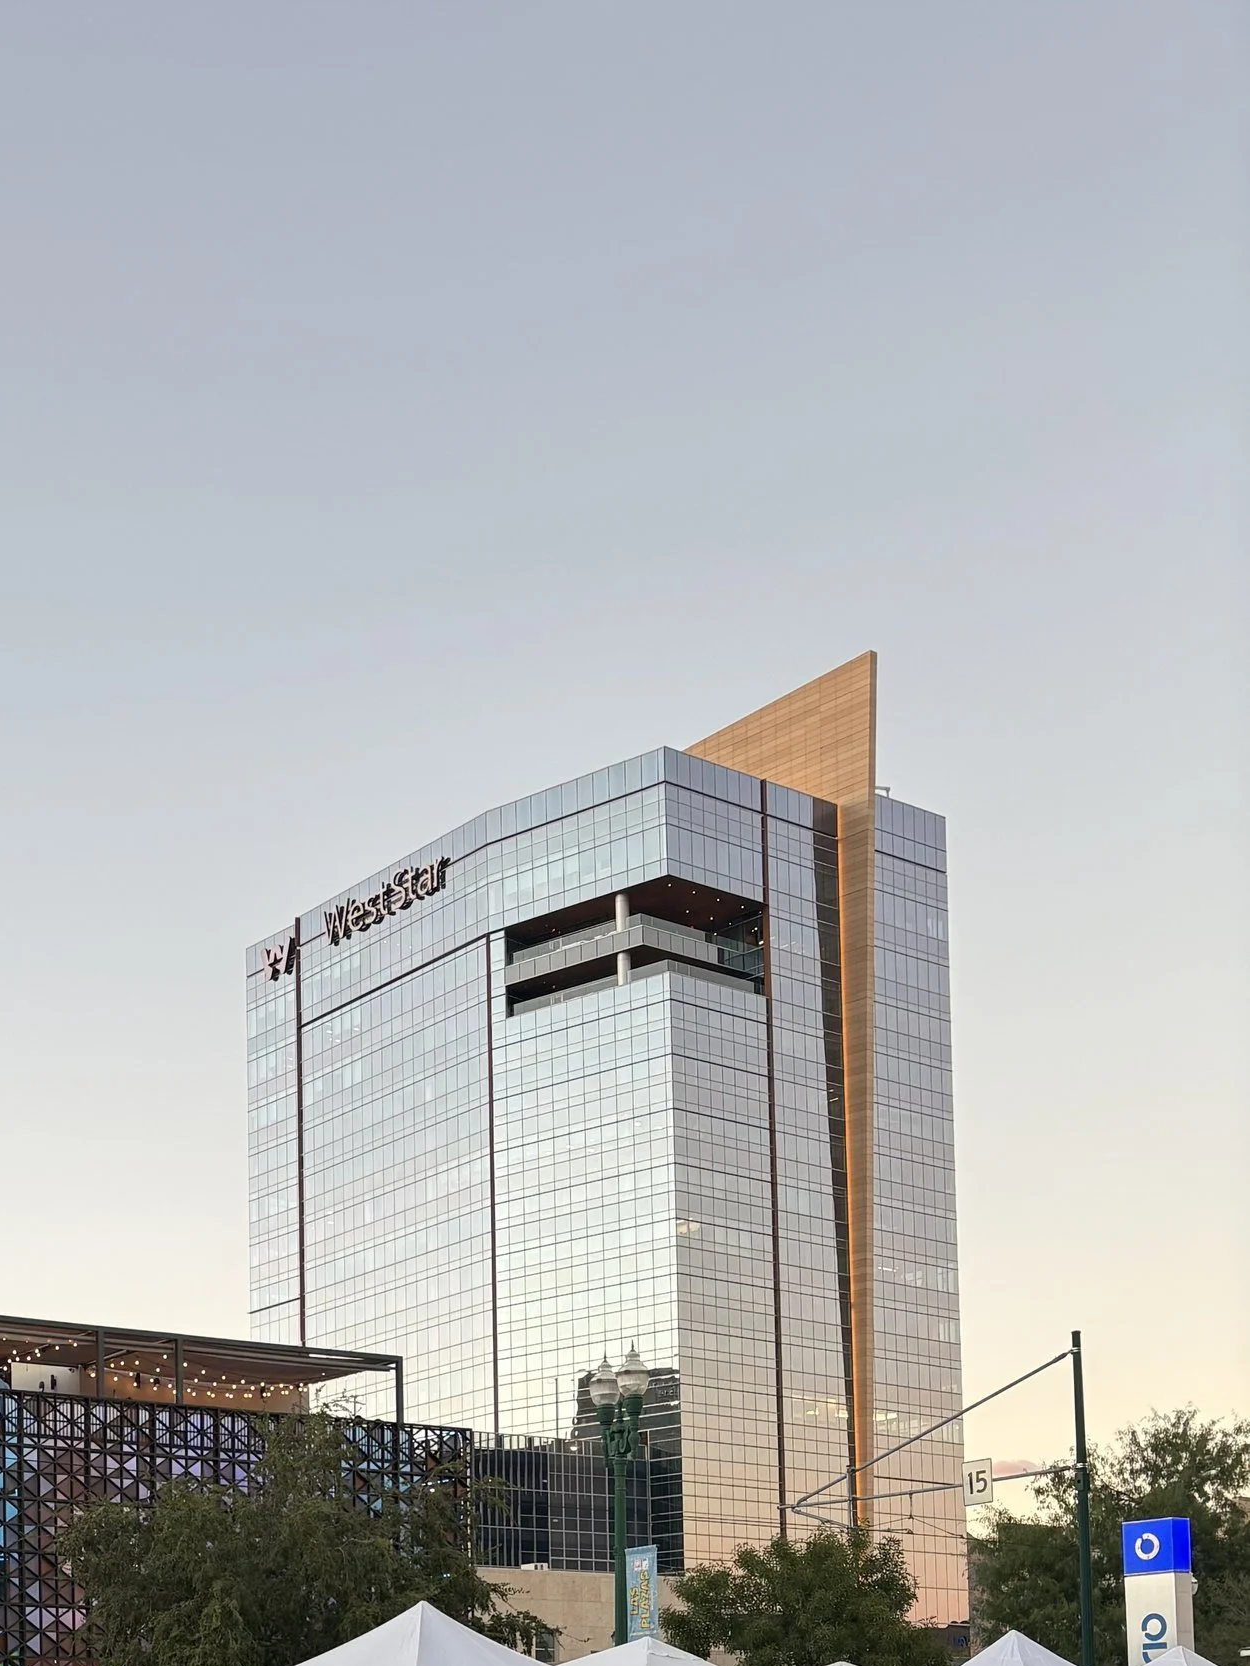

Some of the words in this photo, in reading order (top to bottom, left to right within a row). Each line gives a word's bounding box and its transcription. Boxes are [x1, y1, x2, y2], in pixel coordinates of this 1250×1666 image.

[324, 856, 450, 946] WestStar
[967, 1470, 988, 1494] 15
[630, 1586, 639, 1615] LAS
[640, 1570, 650, 1629] PLAZAS
